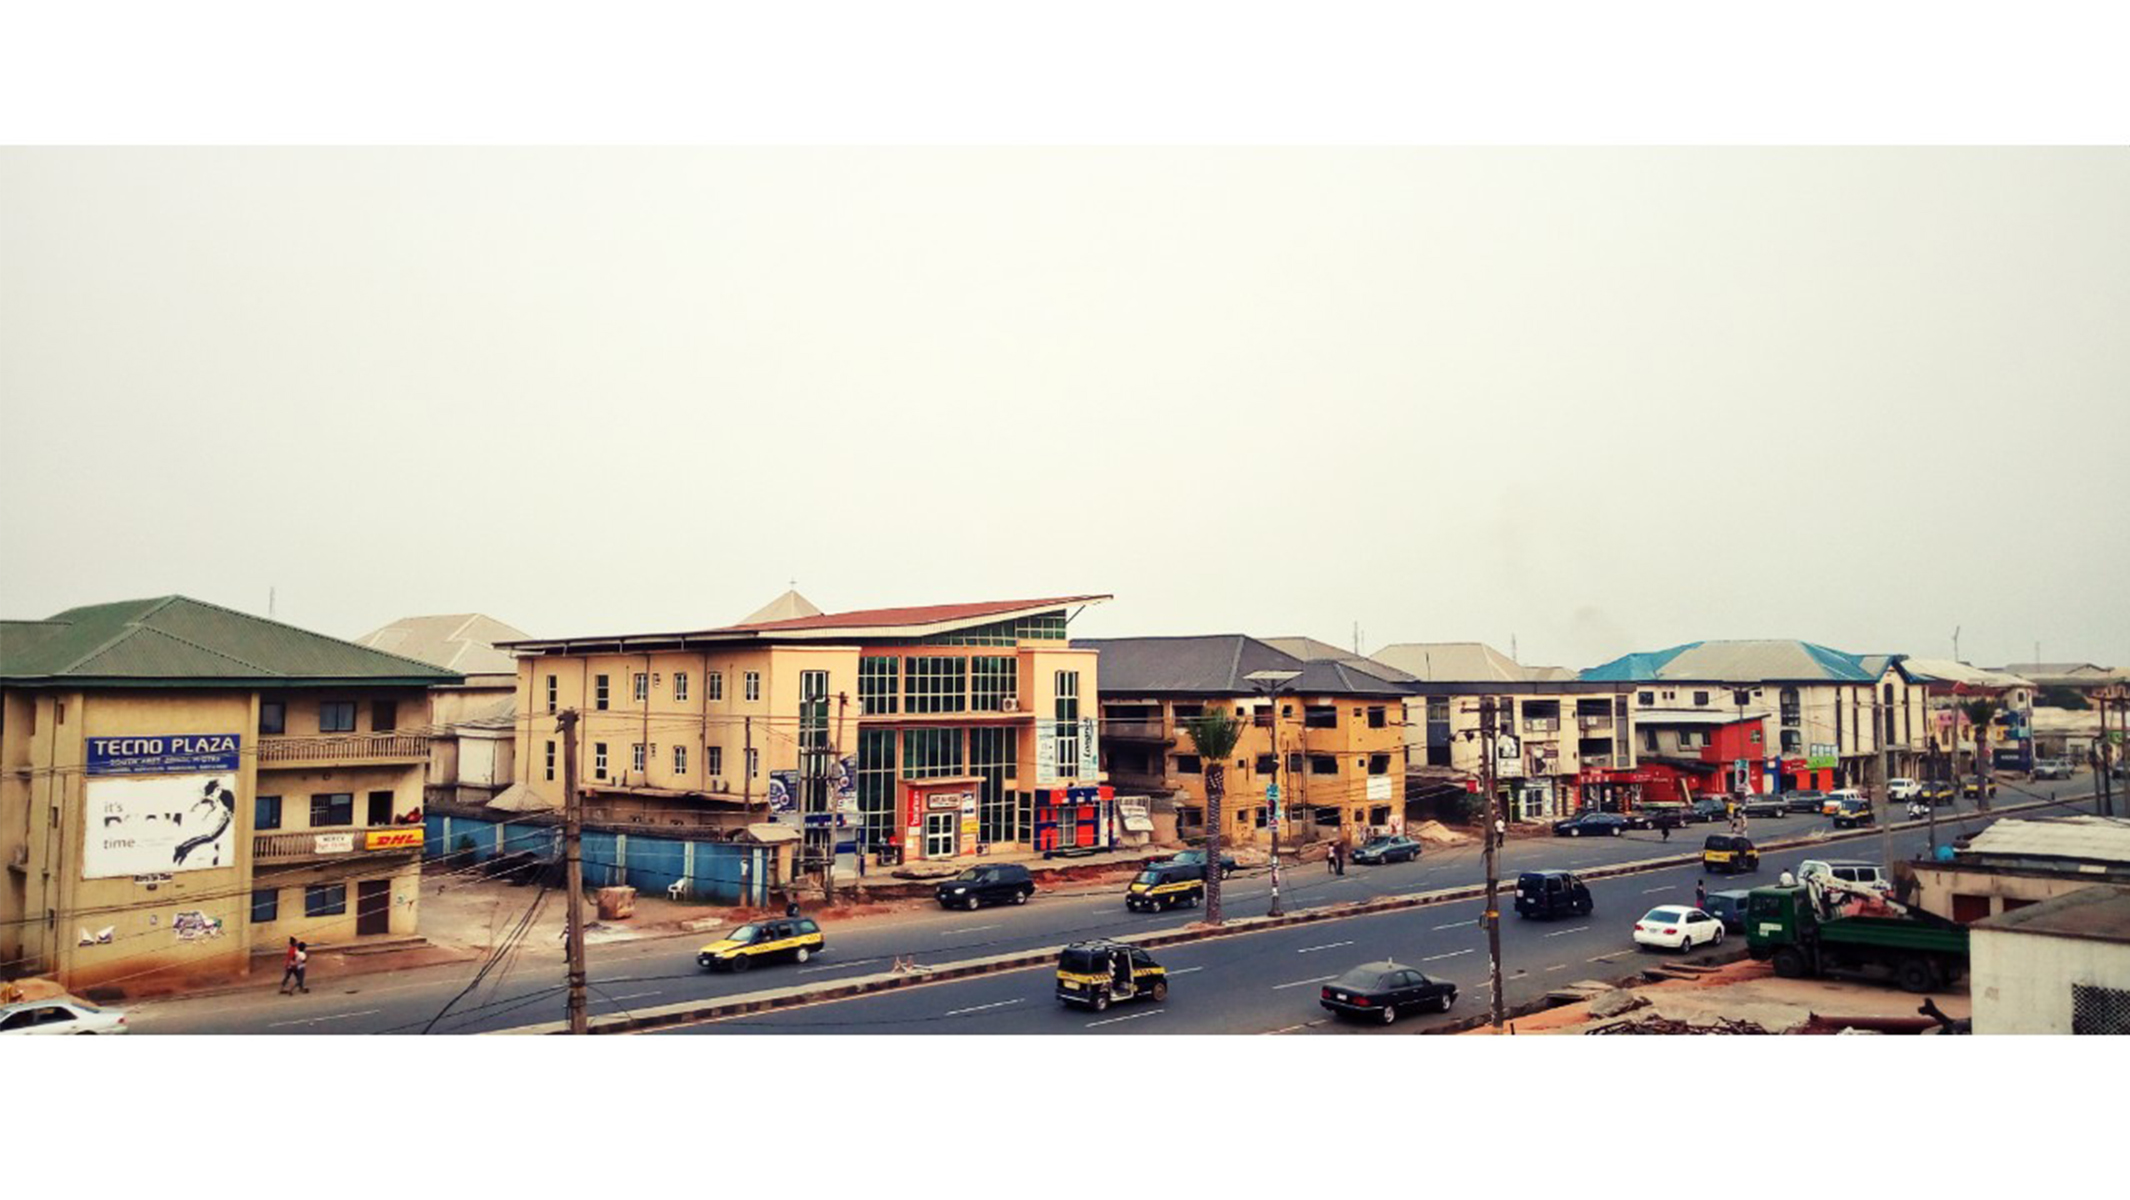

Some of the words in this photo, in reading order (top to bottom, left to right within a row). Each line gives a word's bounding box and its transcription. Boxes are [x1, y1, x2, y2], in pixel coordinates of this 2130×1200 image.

[94, 739, 163, 756] TECNO
[171, 737, 235, 753] PLAZA
[104, 801, 123, 813] it's
[103, 838, 136, 849] time
[376, 834, 420, 845] DHL
